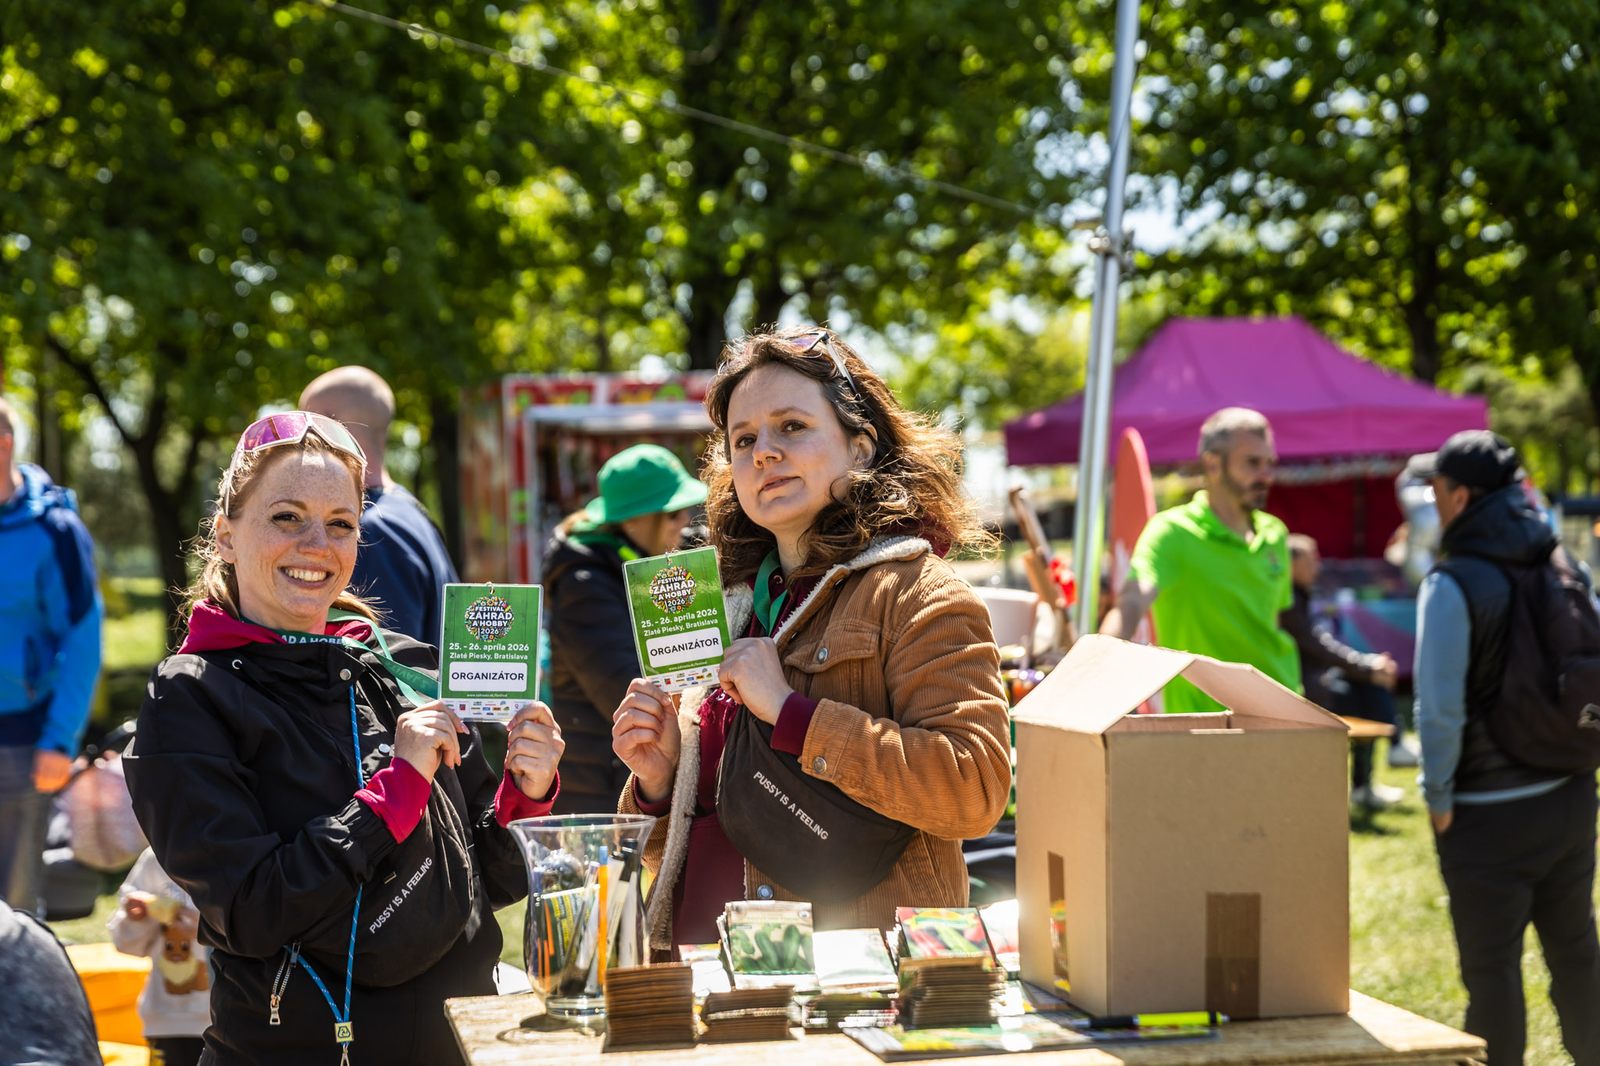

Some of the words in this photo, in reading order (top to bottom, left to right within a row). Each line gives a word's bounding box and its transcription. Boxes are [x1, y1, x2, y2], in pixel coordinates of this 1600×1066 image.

[657, 575, 686, 585] FESTIVAL
[665, 588, 692, 599] HOBBY
[641, 620, 654, 628] 25.
[660, 617, 672, 625] 26.
[697, 608, 718, 618] 2026
[643, 628, 661, 637] Zlaté
[662, 624, 685, 634] Piesky,
[685, 618, 718, 629] Bratislava
[449, 642, 462, 650] 25.
[468, 642, 482, 650] 26.
[507, 643, 530, 651] 2026
[650, 637, 719, 657] ORGANIZÁTOR
[468, 652, 493, 660] Piesky,
[494, 652, 528, 660] Bratislava
[451, 670, 525, 680] ORGANIZÁTOR
[753, 771, 782, 797] PUSSY
[780, 794, 790, 805] IS
[788, 803, 796, 813] A
[795, 808, 829, 840] FEELING
[369, 903, 395, 934] PUSSY
[392, 895, 403, 907] IS
[401, 888, 410, 898] A
[406, 857, 433, 890] FEELING
